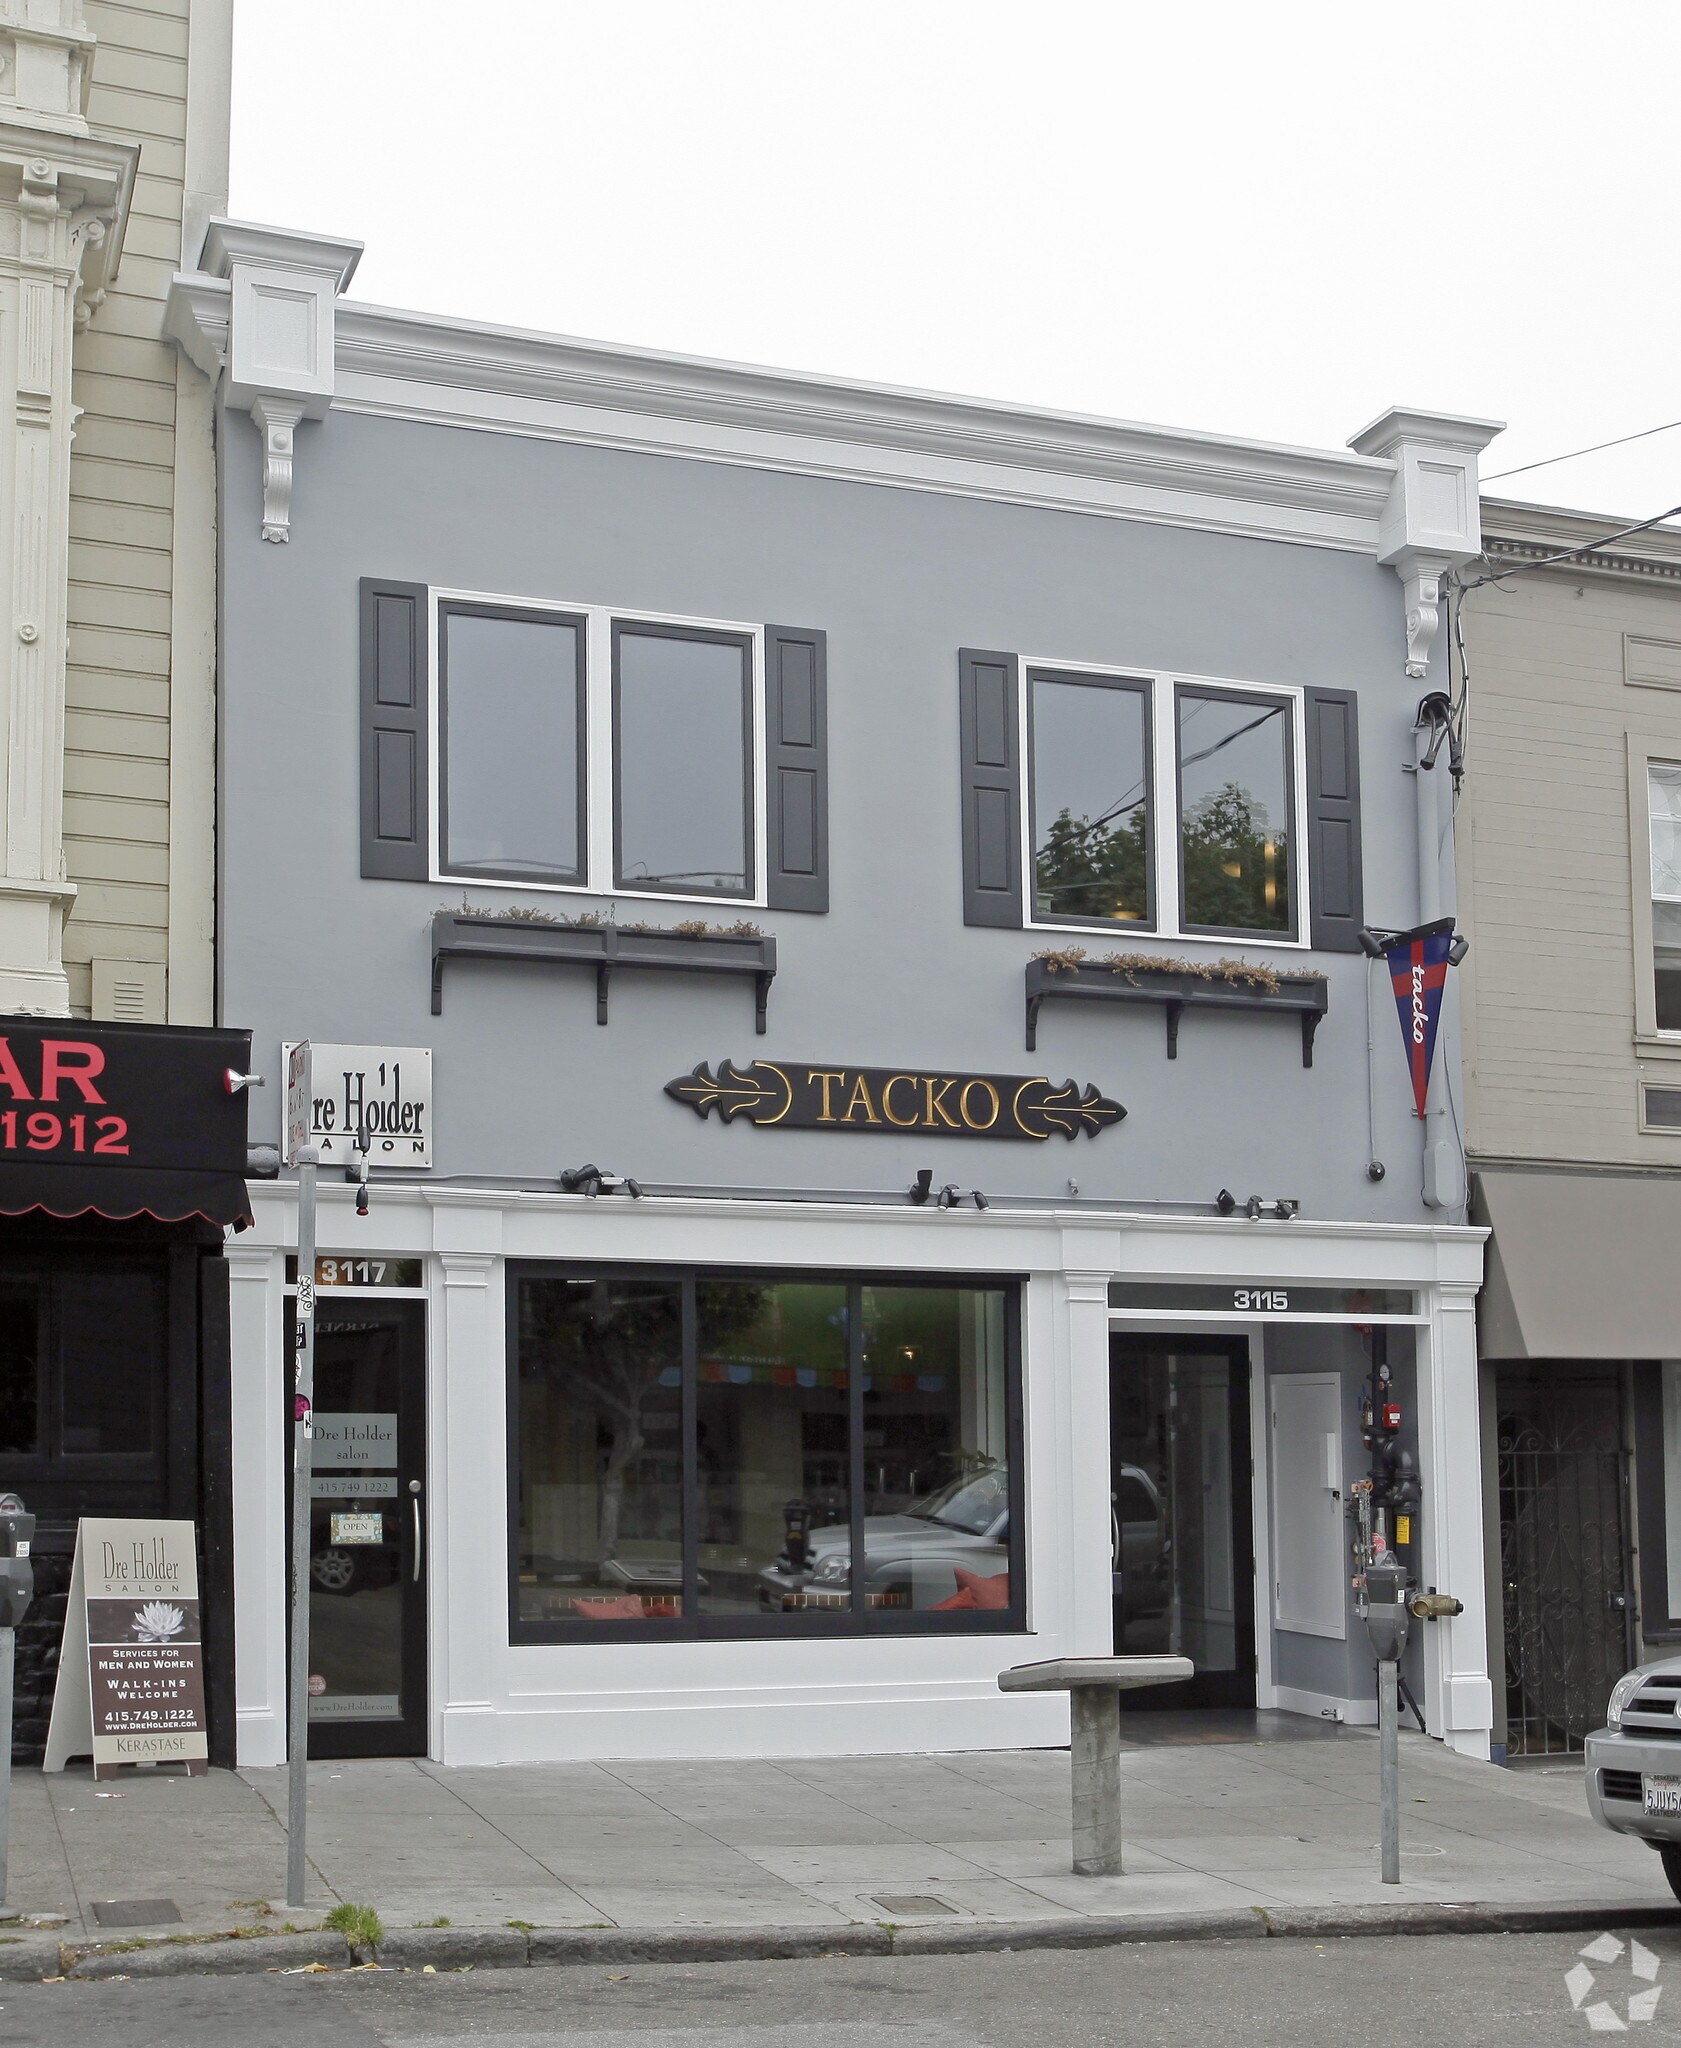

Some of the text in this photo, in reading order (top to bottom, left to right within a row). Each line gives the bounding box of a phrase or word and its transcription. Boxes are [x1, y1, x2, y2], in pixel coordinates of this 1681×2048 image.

[1411, 964, 1429, 1044] tacko
[808, 1070, 1000, 1130] TACKO
[312, 1098, 336, 1131] re
[1, 1111, 129, 1155] 1912
[321, 1260, 387, 1283] 3117
[1233, 1289, 1288, 1311] 3115
[313, 1425, 392, 1441] Dre Holder
[336, 1446, 369, 1460] salon
[343, 1523, 368, 1531] OPEN
[102, 1537, 178, 1579] Dre Holder
[107, 1679, 186, 1689] WALK-INS
[104, 1709, 194, 1721] 415.749.1222
